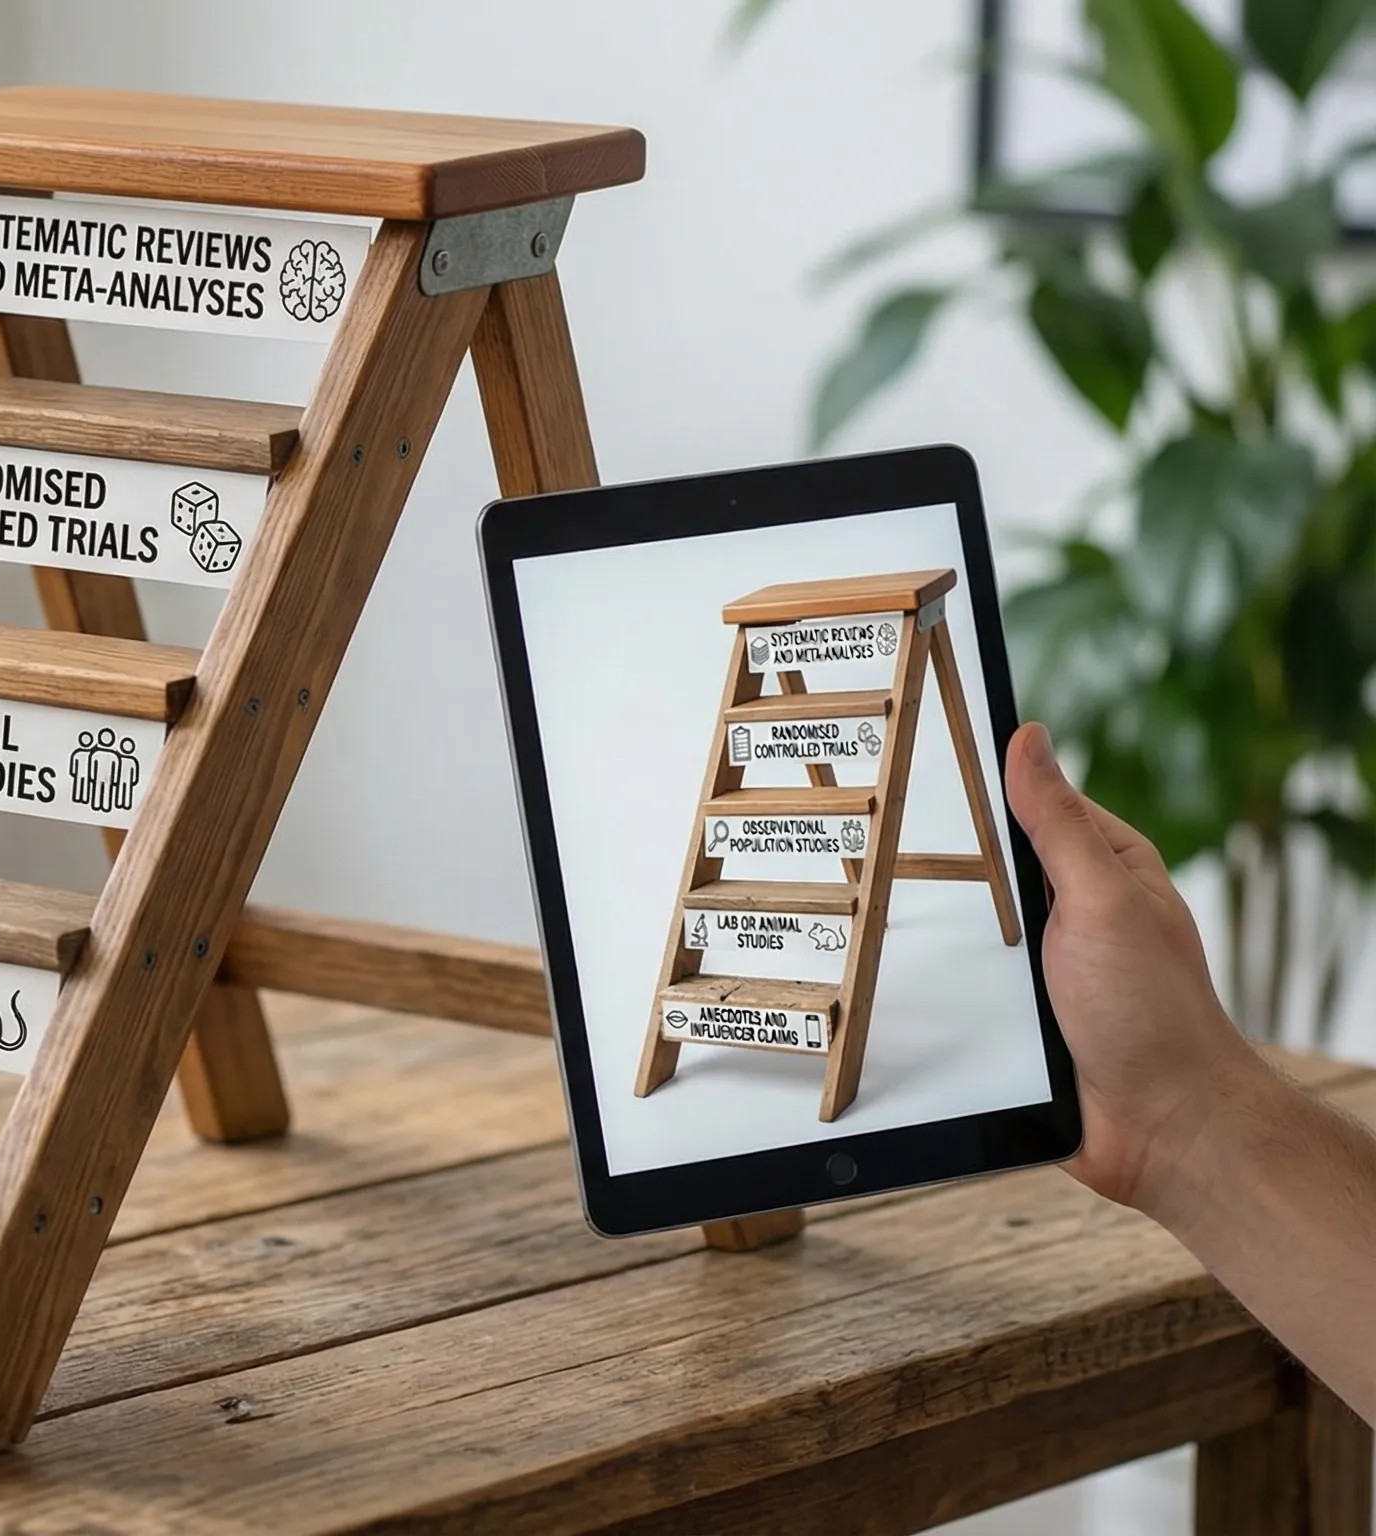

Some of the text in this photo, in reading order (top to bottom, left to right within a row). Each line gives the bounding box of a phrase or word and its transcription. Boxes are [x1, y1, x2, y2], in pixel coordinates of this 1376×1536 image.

[135, 226, 272, 273] REVIEWS
[14, 261, 265, 320] META-ANALYSES
[48, 515, 159, 564] TRIALS
[717, 915, 738, 930] LAB
[741, 916, 756, 931] OR
[737, 933, 784, 950] STUDIES
